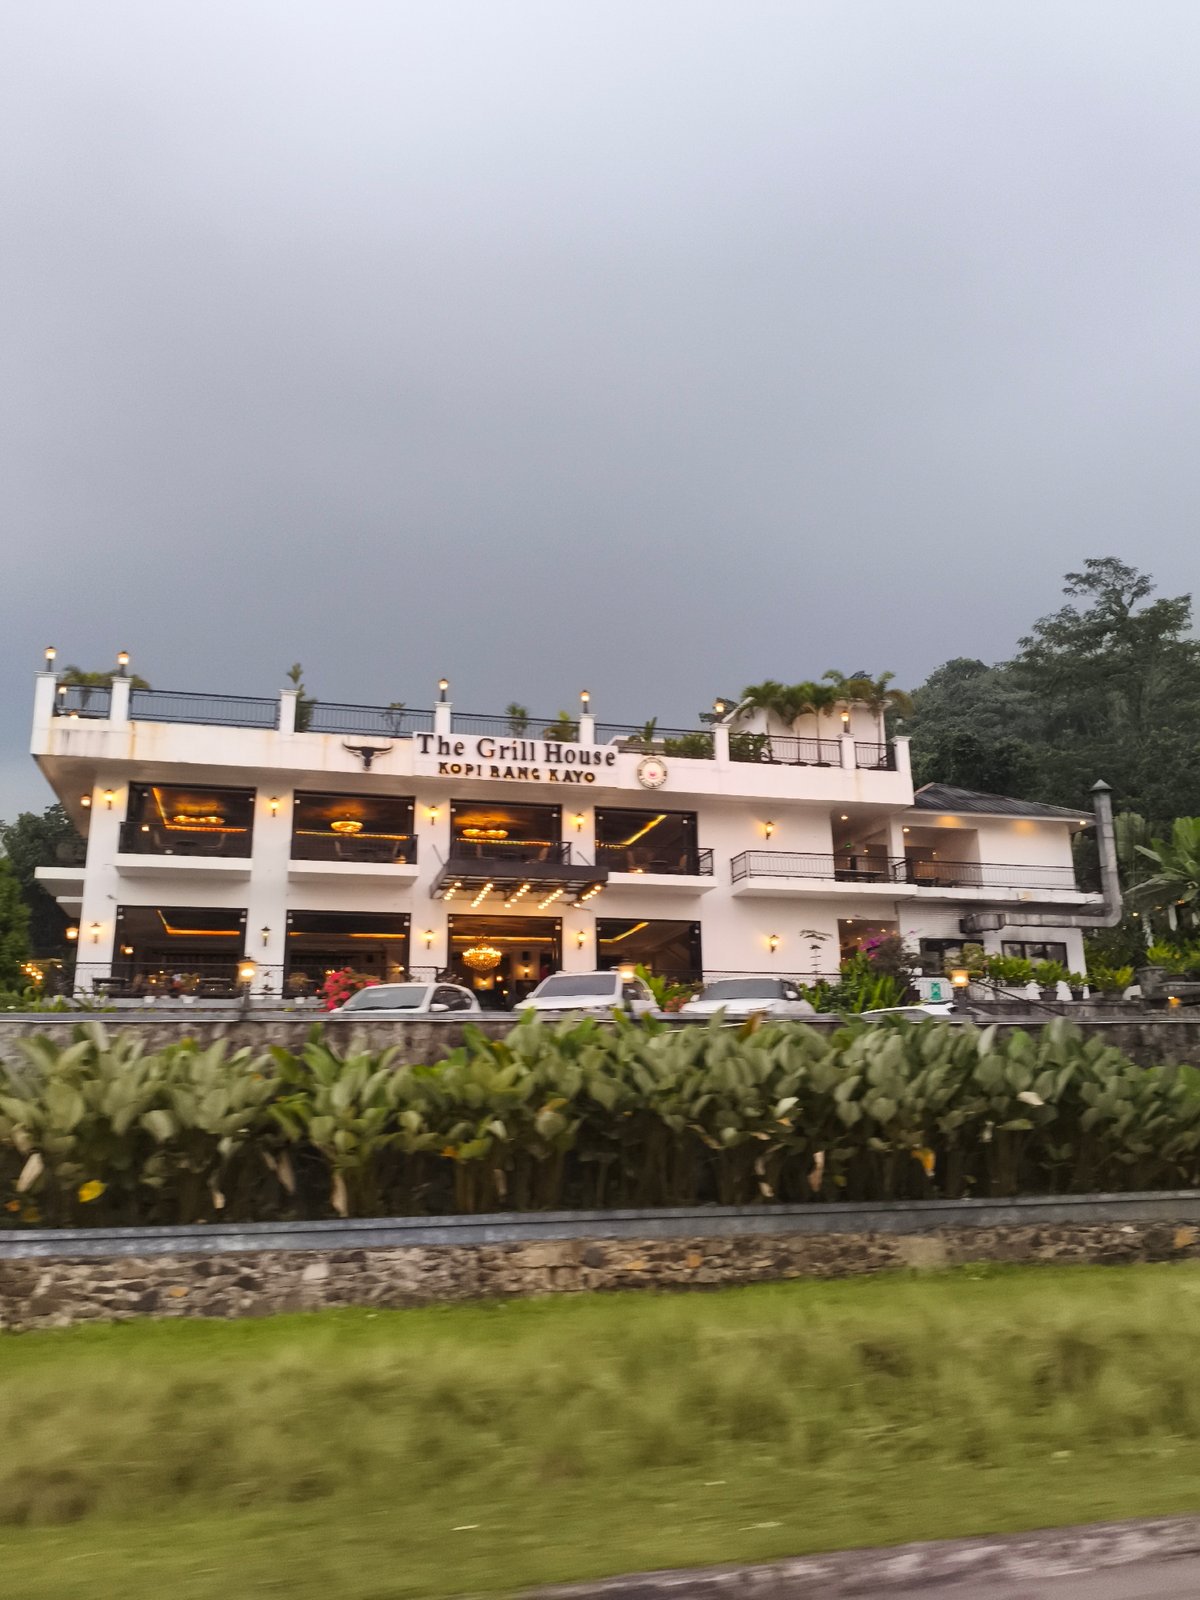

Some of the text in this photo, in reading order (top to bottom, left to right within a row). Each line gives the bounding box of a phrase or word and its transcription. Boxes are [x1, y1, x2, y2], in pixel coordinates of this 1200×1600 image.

[417, 733, 616, 766] The Grill House
[438, 761, 482, 776] KOPI
[549, 768, 596, 783] KAYO
